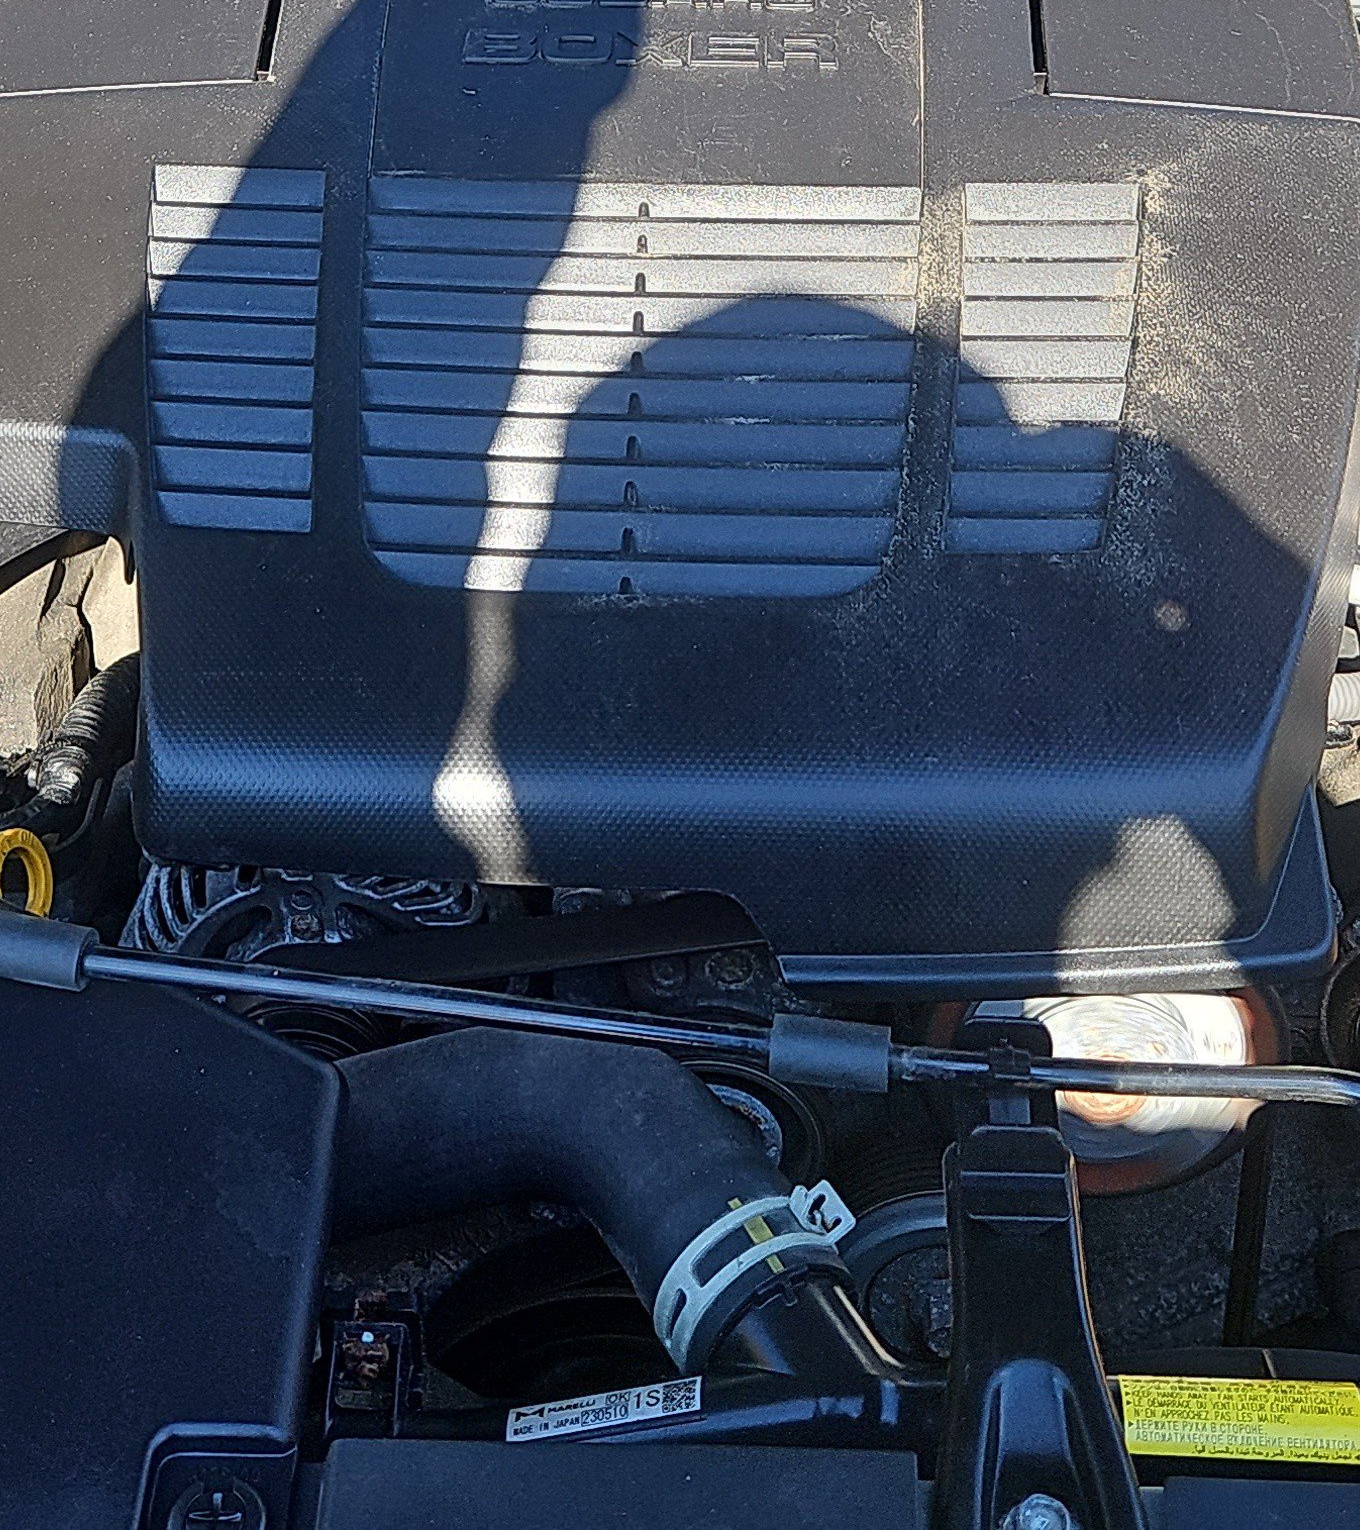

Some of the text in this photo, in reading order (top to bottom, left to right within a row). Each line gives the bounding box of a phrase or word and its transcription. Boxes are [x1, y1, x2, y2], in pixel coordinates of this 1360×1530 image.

[464, 28, 839, 70] BOXER
[1132, 1398, 1143, 1407] LE
[1196, 1400, 1207, 1409] DU
[1213, 1401, 1266, 1412] VENTILATEUR
[1217, 1393, 1234, 1401] FAN
[1239, 1394, 1269, 1403] STARTS
[547, 1399, 596, 1414] MARELLI
[1161, 1409, 1210, 1421] APPROCHEZ
[1214, 1411, 1231, 1421] PAS
[1236, 1412, 1253, 1423] LES
[513, 1423, 534, 1436] MADE
[540, 1421, 550, 1431] IN
[554, 1416, 580, 1429] JAPAN
